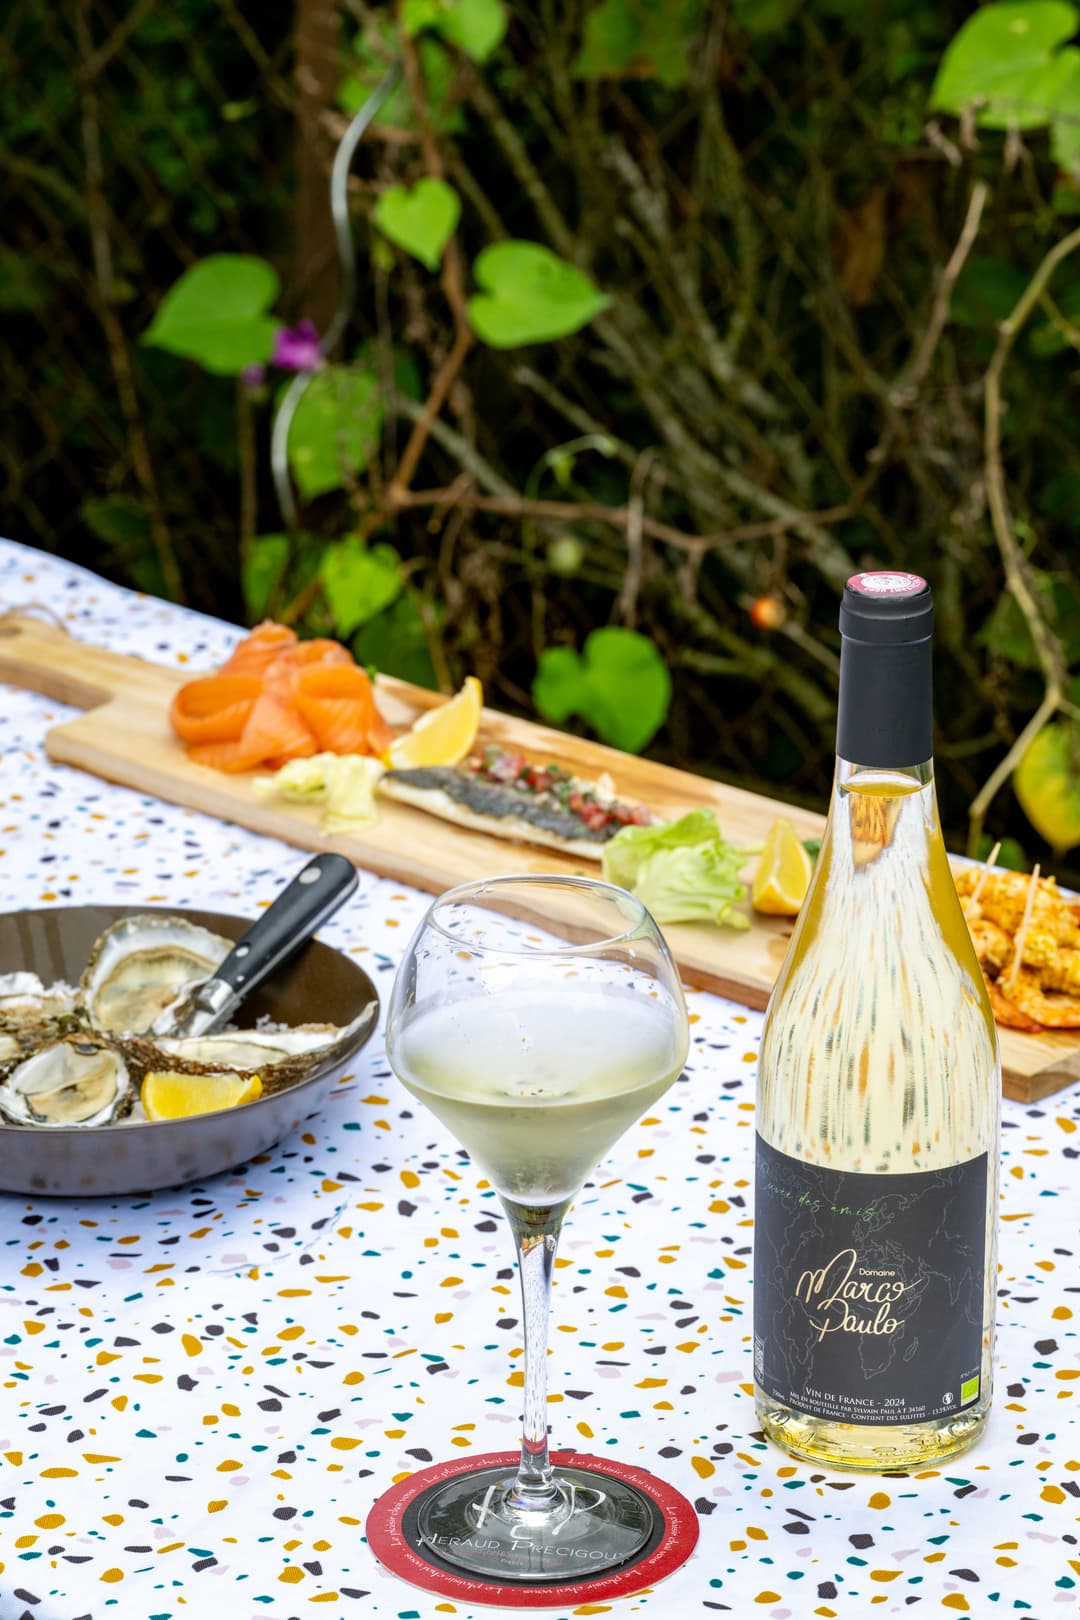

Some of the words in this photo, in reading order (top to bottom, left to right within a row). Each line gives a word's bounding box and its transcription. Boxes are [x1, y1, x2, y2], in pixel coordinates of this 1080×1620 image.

[796, 1248, 923, 1310] Marco
[858, 1267, 896, 1277] Domaine
[809, 1298, 905, 1342] Paulo
[805, 1386, 822, 1398] VIN
[824, 1393, 836, 1402] DE
[839, 1395, 875, 1407] FRANCE
[884, 1398, 905, 1407] 2024
[809, 1398, 839, 1410] BOUTEILLE
[822, 1408, 846, 1418] FRANCE
[851, 1413, 884, 1421] CONTIENT
[423, 1474, 438, 1484] Le
[441, 1463, 474, 1479] plaisir
[477, 1457, 502, 1467] chai
[586, 1462, 623, 1475] plaisir
[625, 1569, 641, 1578] Le
[445, 1576, 484, 1591] plaisir
[485, 1585, 504, 1595] Le
[587, 1575, 622, 1591] plaisir
